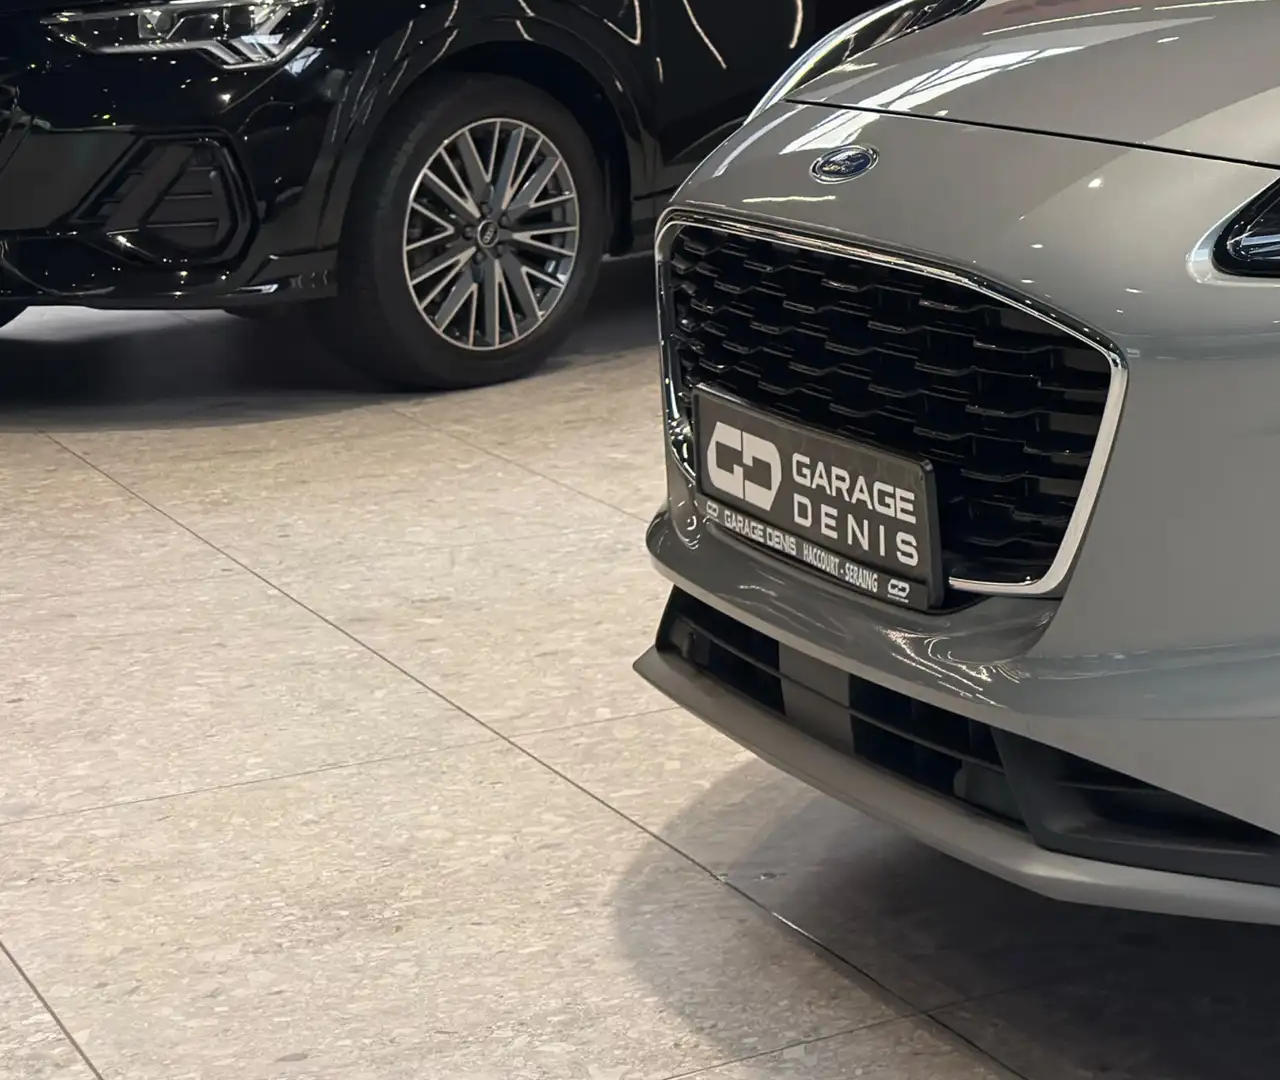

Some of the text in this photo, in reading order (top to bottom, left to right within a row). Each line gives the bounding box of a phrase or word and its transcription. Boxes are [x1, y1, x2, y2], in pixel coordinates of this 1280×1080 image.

[792, 452, 917, 524] GARAGE
[724, 510, 765, 543] GARAGE
[766, 525, 797, 556] DENIS
[803, 543, 840, 577] HACCOURT
[845, 561, 878, 593] SERAING
[793, 493, 919, 567] DENIS
